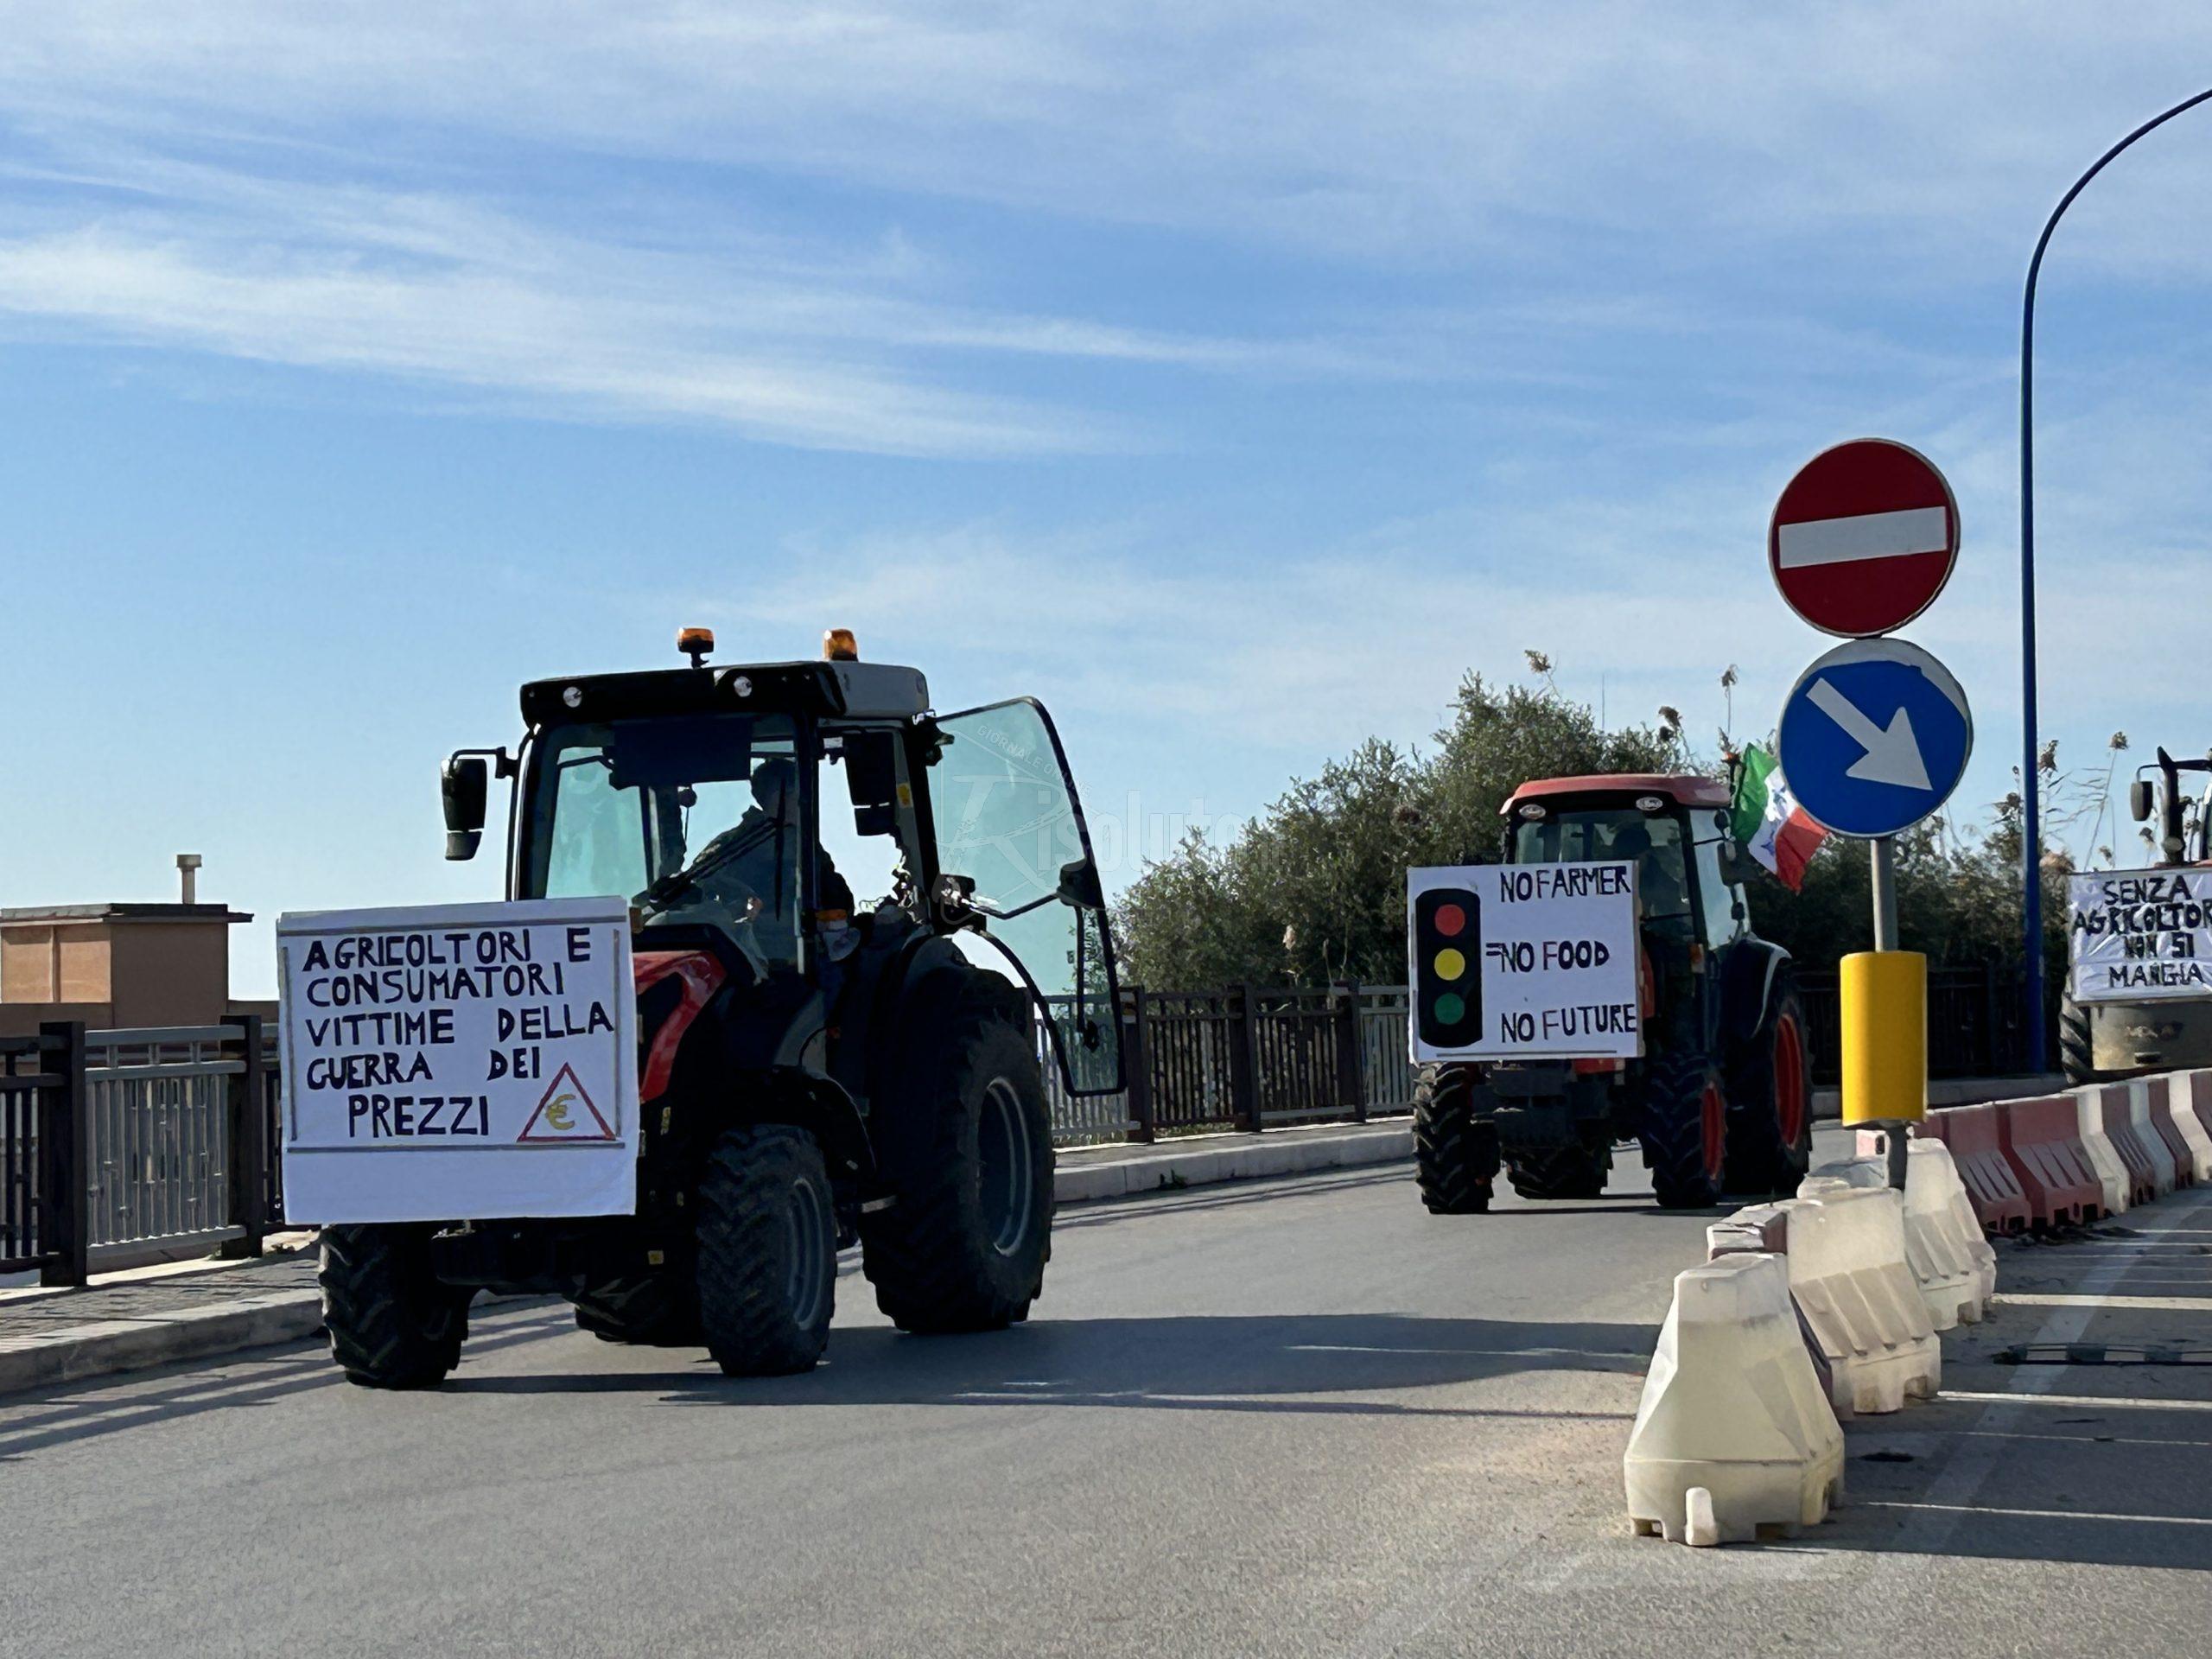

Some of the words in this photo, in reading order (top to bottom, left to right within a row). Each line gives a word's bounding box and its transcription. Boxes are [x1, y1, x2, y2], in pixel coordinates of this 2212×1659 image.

[1500, 871, 1533, 903] NO
[1535, 866, 1631, 899] FARMER
[2102, 875, 2193, 905] SENZA
[302, 928, 531, 972] AGRICOLTORI
[567, 927, 591, 963] E
[1542, 940, 1610, 970] FOOD
[2171, 931, 2195, 958] SI
[306, 962, 565, 1007] CONSUMATORI
[2108, 963, 2204, 988] MANGIA
[305, 1008, 455, 1046] VITTIME
[498, 1001, 614, 1043] DELLA
[1501, 1012, 1535, 1043] NO
[1542, 1003, 1637, 1039] FUTURE
[307, 1051, 433, 1090] GUERRA
[486, 1046, 541, 1081] DEI
[347, 1094, 489, 1138] PREZZI
